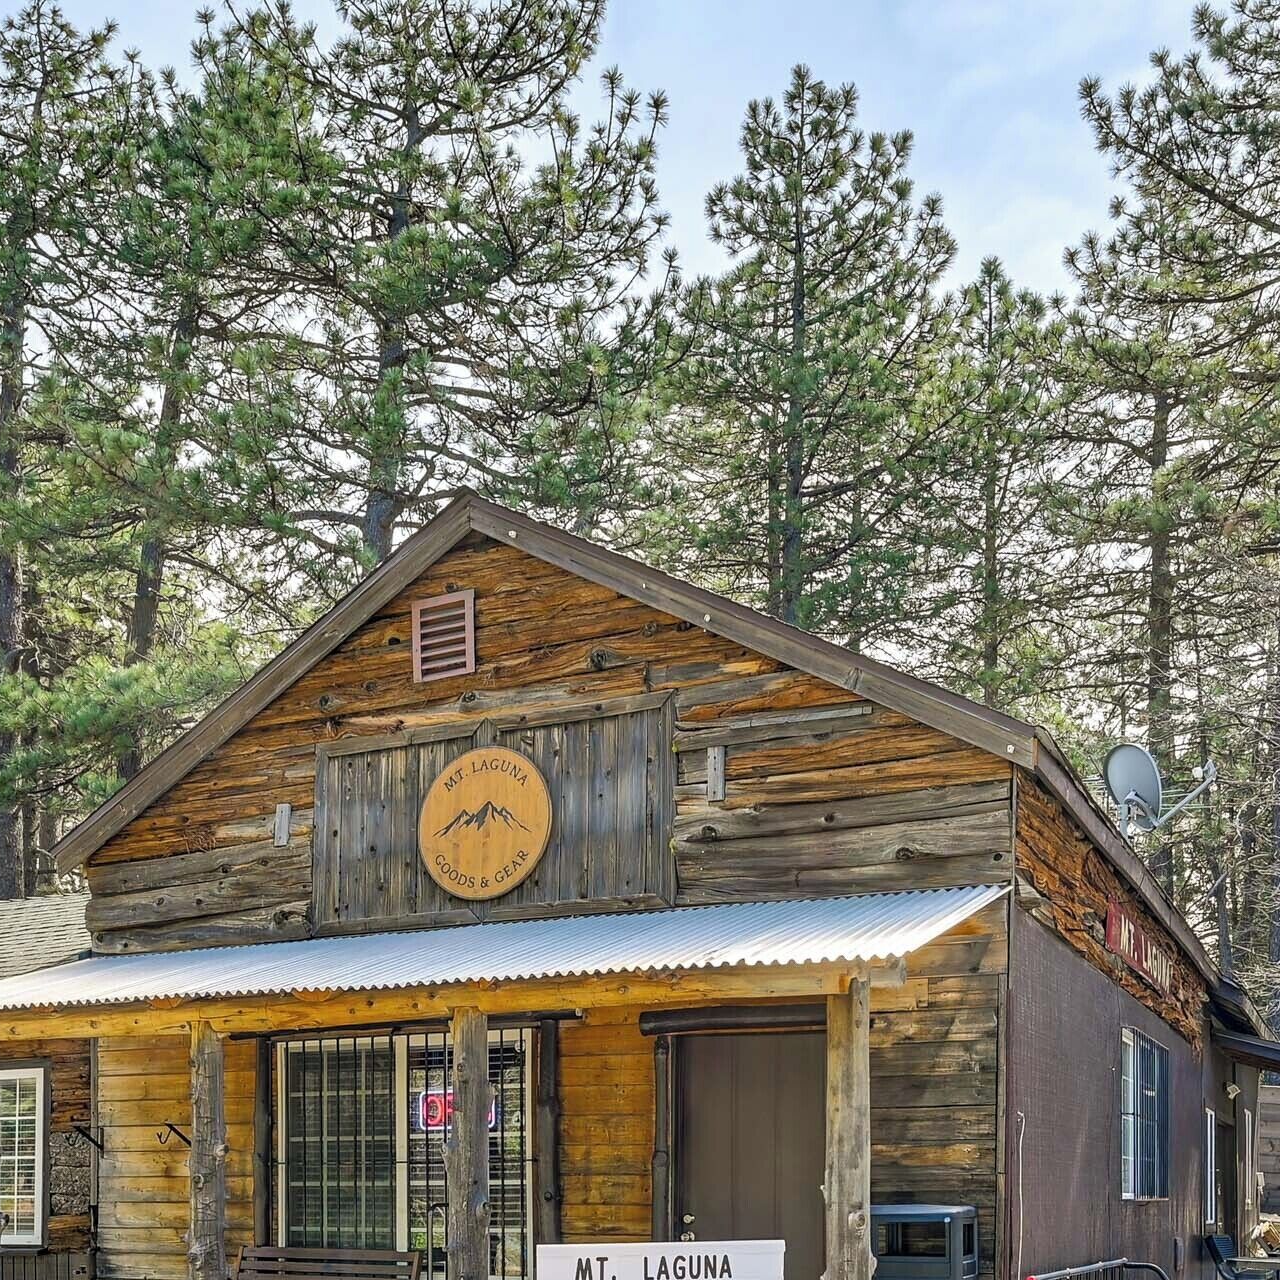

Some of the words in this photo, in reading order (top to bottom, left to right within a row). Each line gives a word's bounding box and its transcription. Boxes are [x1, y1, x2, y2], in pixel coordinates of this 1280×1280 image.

[443, 768, 469, 792] MT.
[471, 758, 529, 787] LAGUNA
[435, 854, 476, 888] GOODS
[480, 876, 490, 888] &
[494, 850, 529, 883] GEAR
[643, 1254, 733, 1280] LAGUNA
